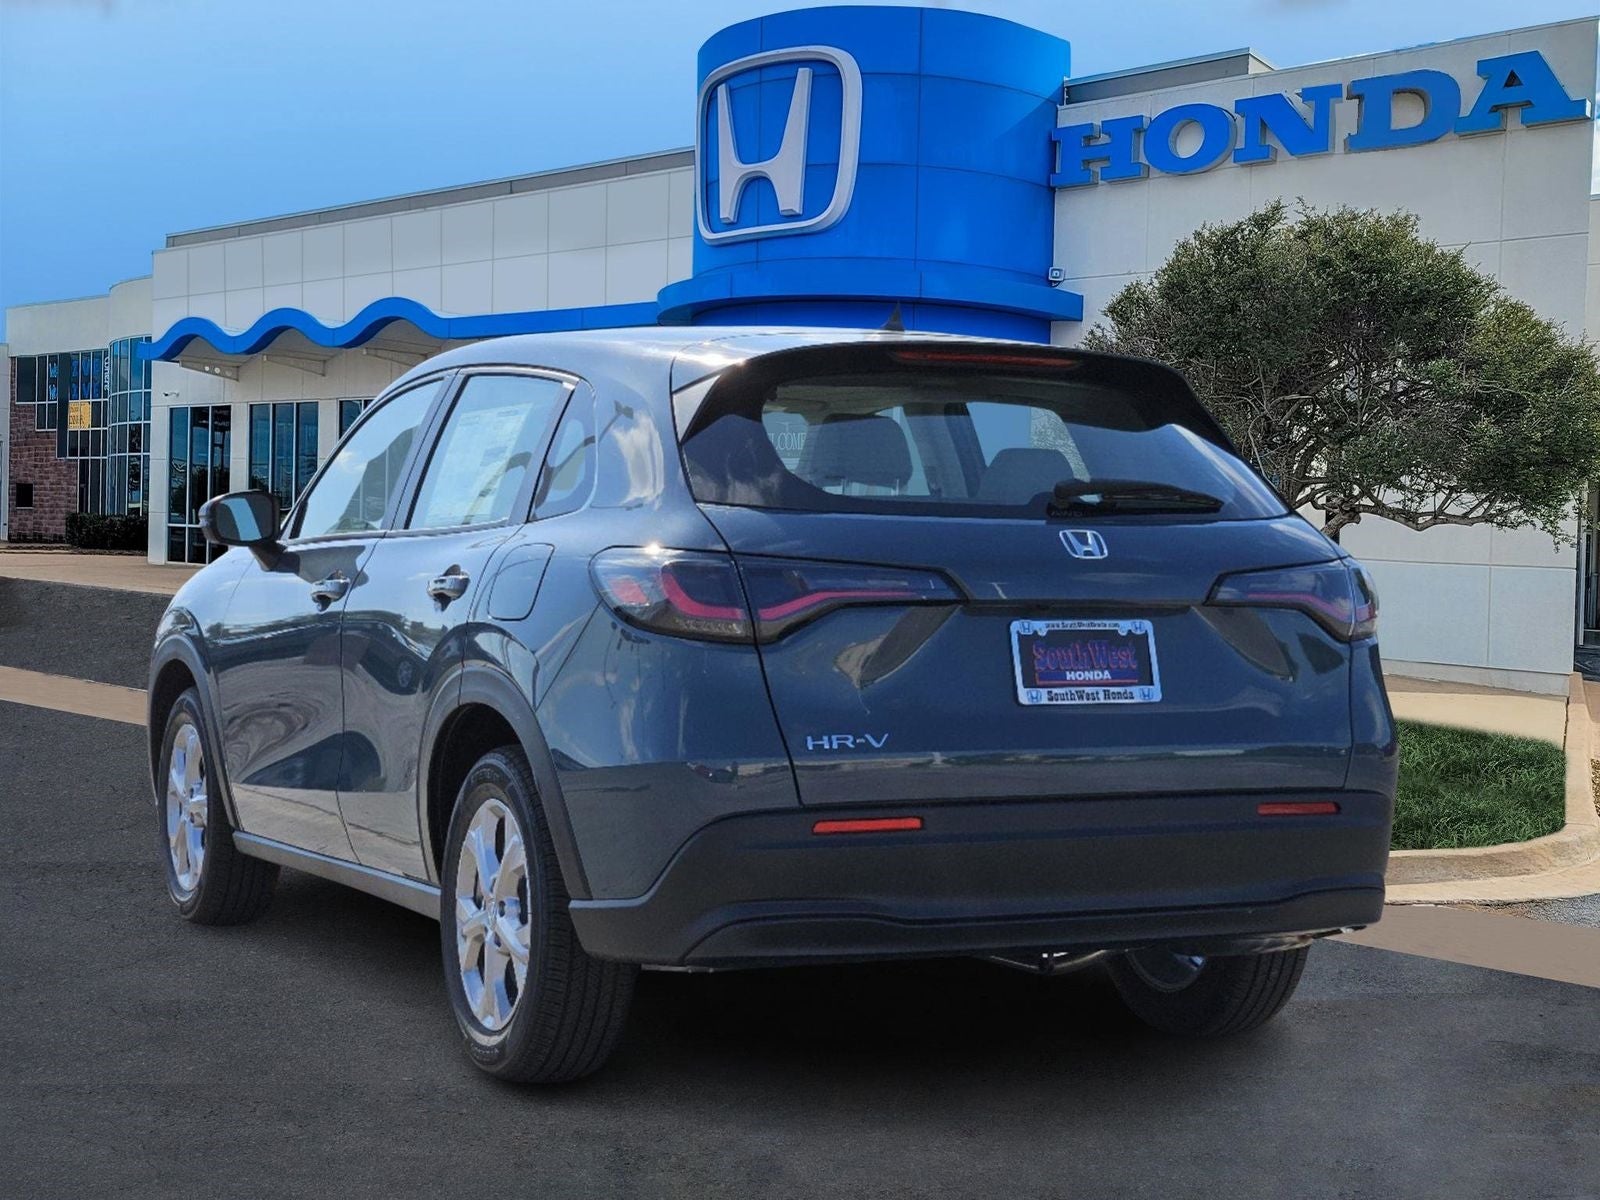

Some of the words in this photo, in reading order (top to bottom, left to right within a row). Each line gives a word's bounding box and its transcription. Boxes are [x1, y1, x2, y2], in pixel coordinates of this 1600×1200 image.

[1050, 50, 1591, 189] HONDA
[1033, 640, 1138, 671] SouthWest
[1066, 670, 1112, 681] HONDA
[1047, 690, 1100, 702] SouthWest
[1103, 689, 1135, 700] Honda
[806, 733, 889, 751] HR-V
